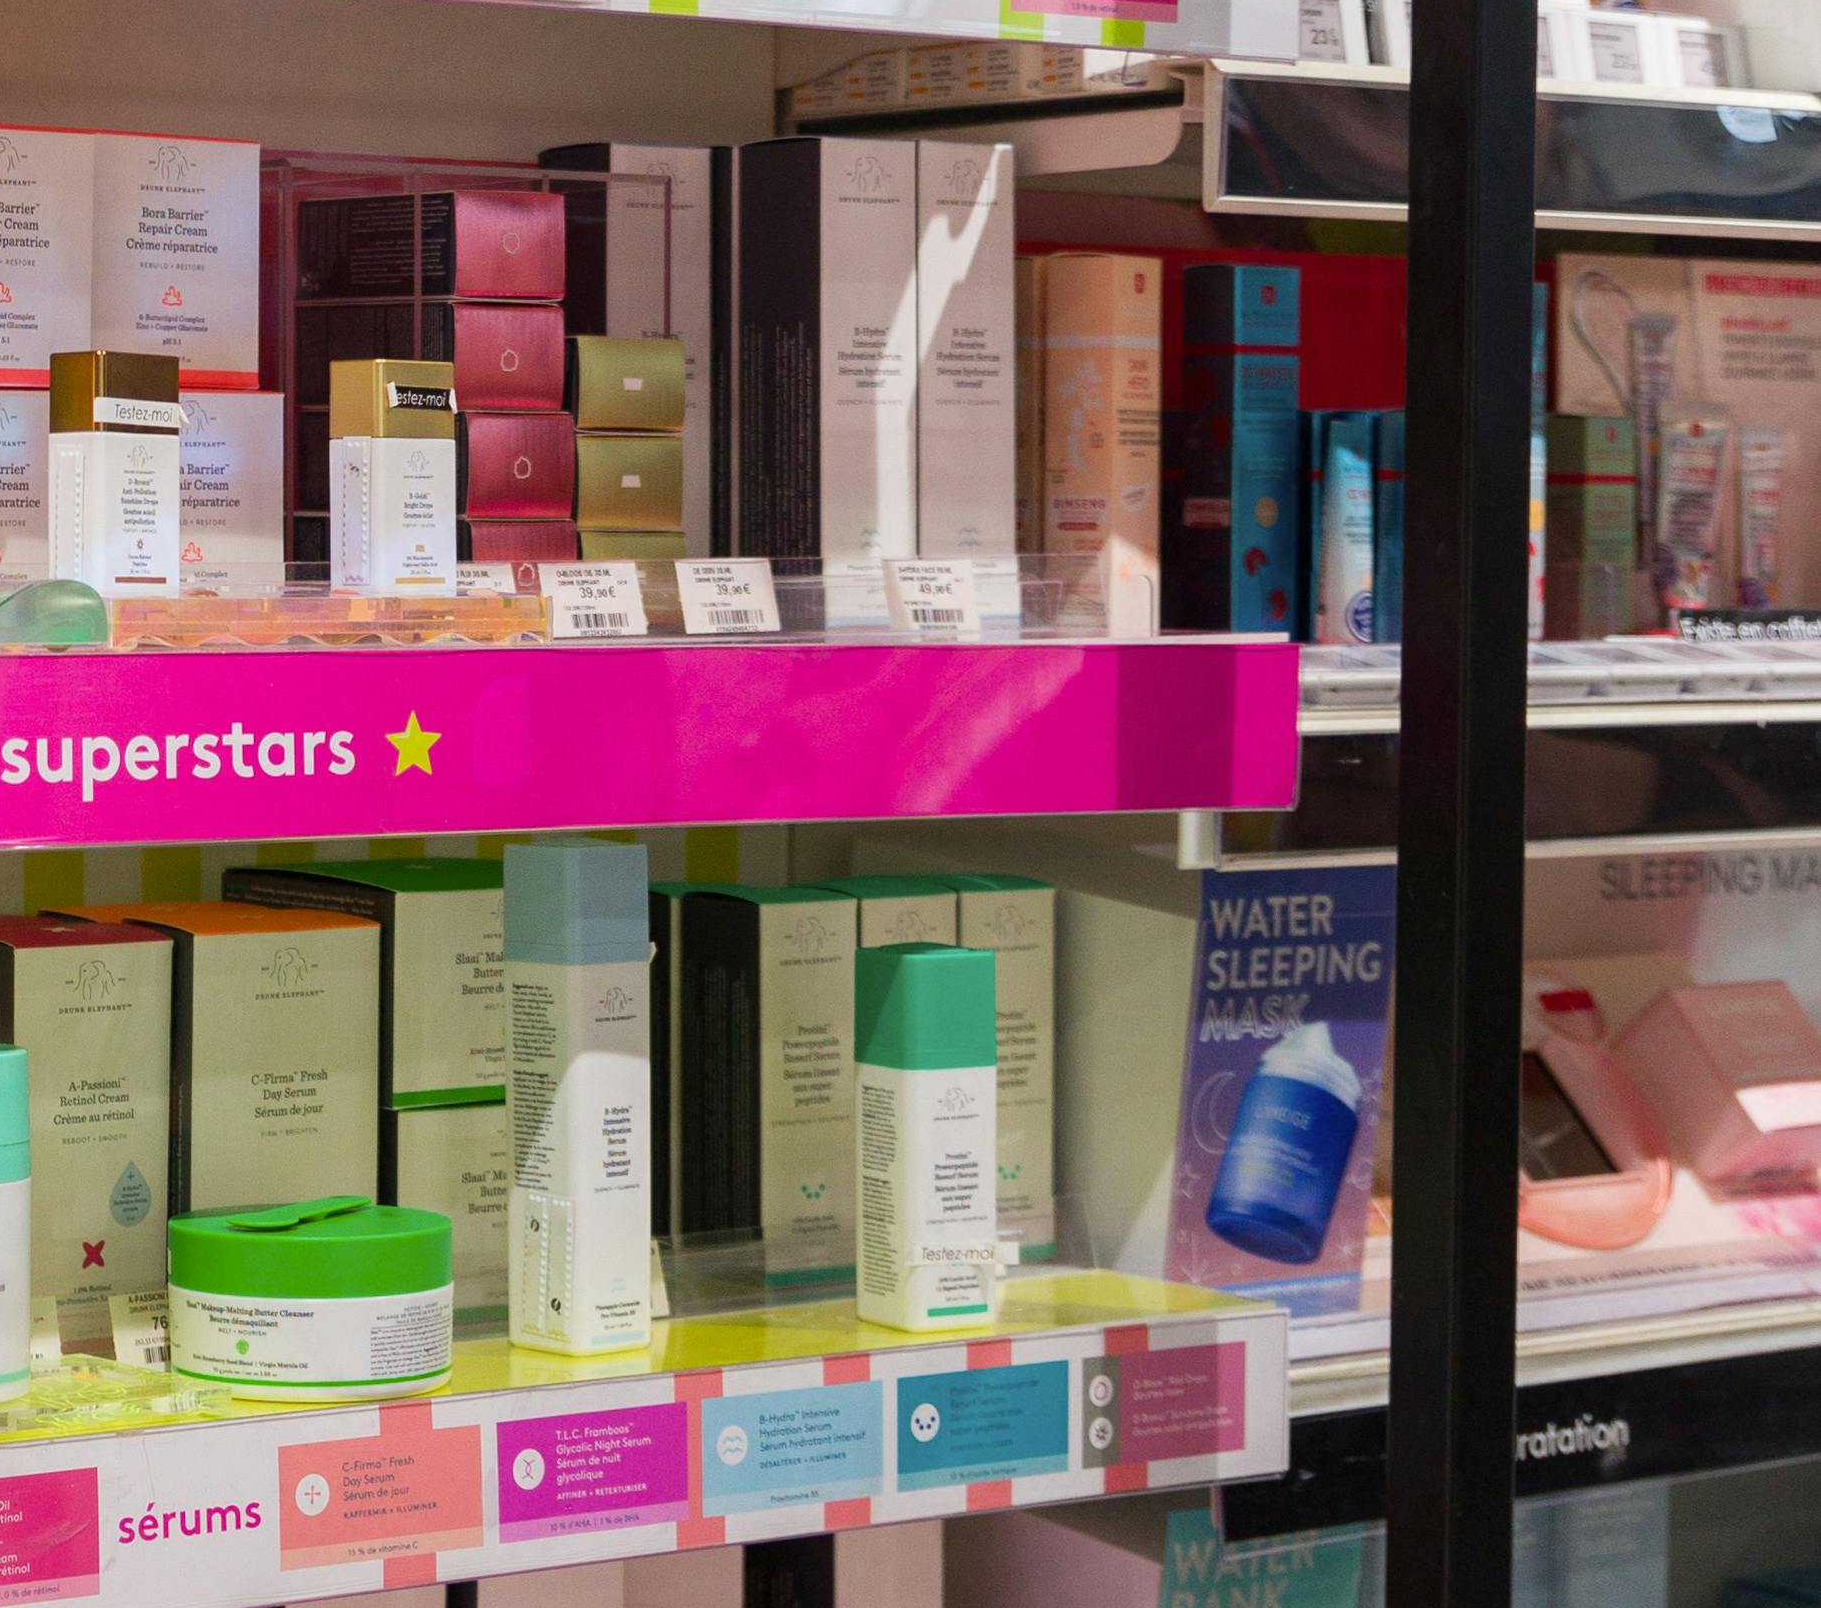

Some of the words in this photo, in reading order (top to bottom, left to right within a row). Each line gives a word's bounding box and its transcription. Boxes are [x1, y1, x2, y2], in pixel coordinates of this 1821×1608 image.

[4, 219, 39, 231] Cream
[114, 404, 173, 424] Testez-moi
[0, 720, 357, 802] superstars
[1598, 856, 1764, 901] SLEEPING
[1207, 895, 1335, 940] WATER
[1207, 943, 1383, 991] SLEEPING
[300, 1069, 328, 1082] Fresh
[60, 1095, 96, 1107] Retinol
[98, 1093, 130, 1105] Cream
[263, 1089, 282, 1102] Day
[283, 1087, 317, 1099] Serum
[54, 1113, 88, 1125] Crème
[90, 1113, 102, 1123] au
[104, 1109, 134, 1121] rétinol
[254, 1105, 288, 1119] Sérum
[290, 1104, 302, 1116] de
[303, 1104, 324, 1117] jour
[920, 1245, 996, 1263] Testez-moi
[759, 1425, 803, 1440] Hydration
[804, 1422, 832, 1434] Serum
[1516, 1415, 1629, 1461] ratation
[555, 1441, 593, 1456] Glycolic
[594, 1439, 620, 1454] Night
[622, 1436, 651, 1448] Serum
[343, 1475, 362, 1488] Day
[364, 1472, 395, 1486] Serum
[117, 1499, 262, 1545] sérums
